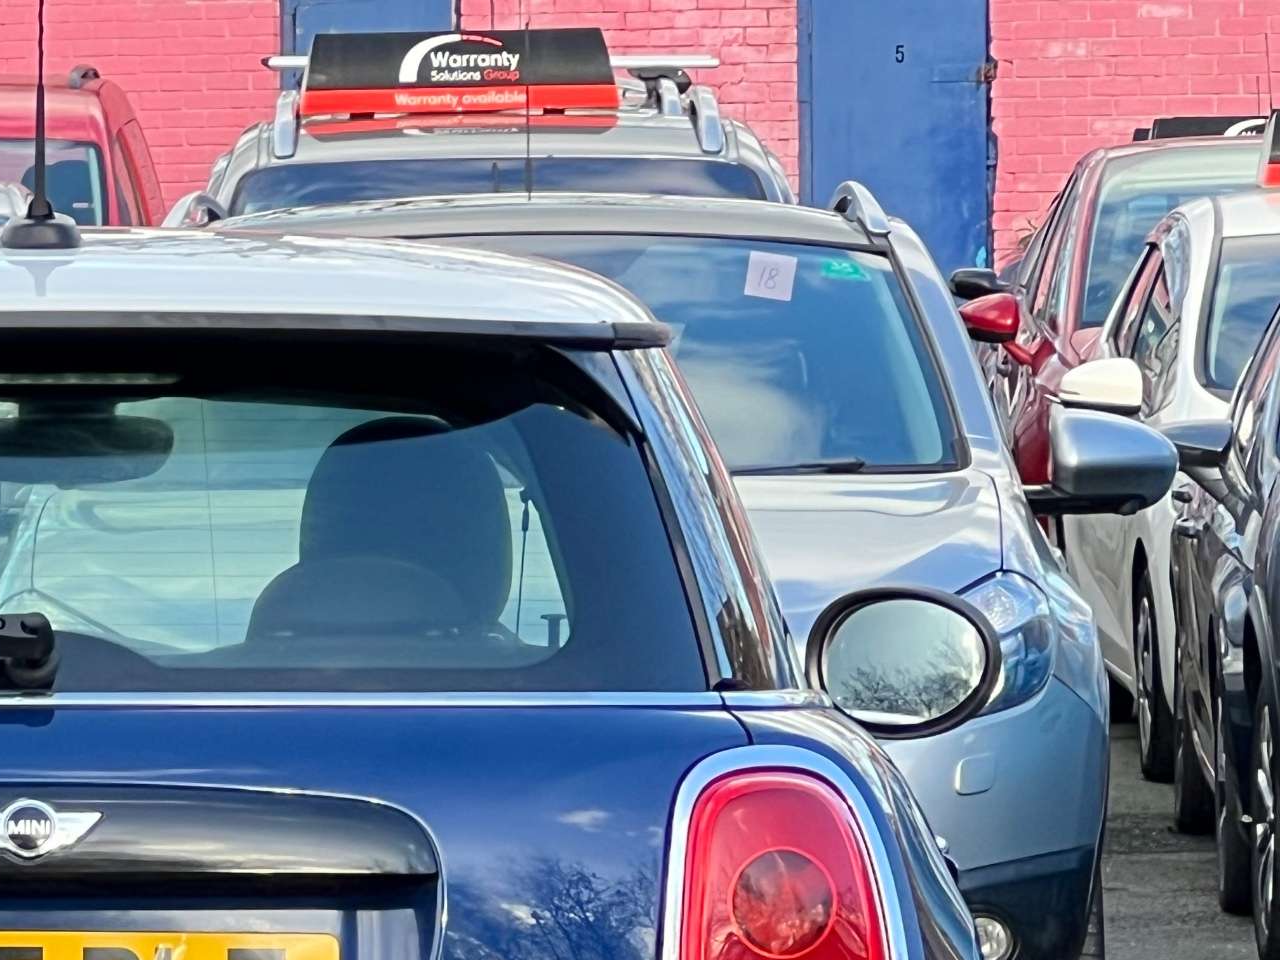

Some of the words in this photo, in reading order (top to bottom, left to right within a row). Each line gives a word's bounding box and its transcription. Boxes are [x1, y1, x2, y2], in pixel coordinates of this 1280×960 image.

[430, 51, 520, 71] Warranty
[895, 44, 905, 64] 5
[430, 70, 481, 81] Solutions
[483, 69, 520, 81] Group
[395, 92, 458, 108] Warranty
[462, 90, 527, 105] available
[758, 265, 782, 290] 18
[8, 819, 51, 835] MINI
